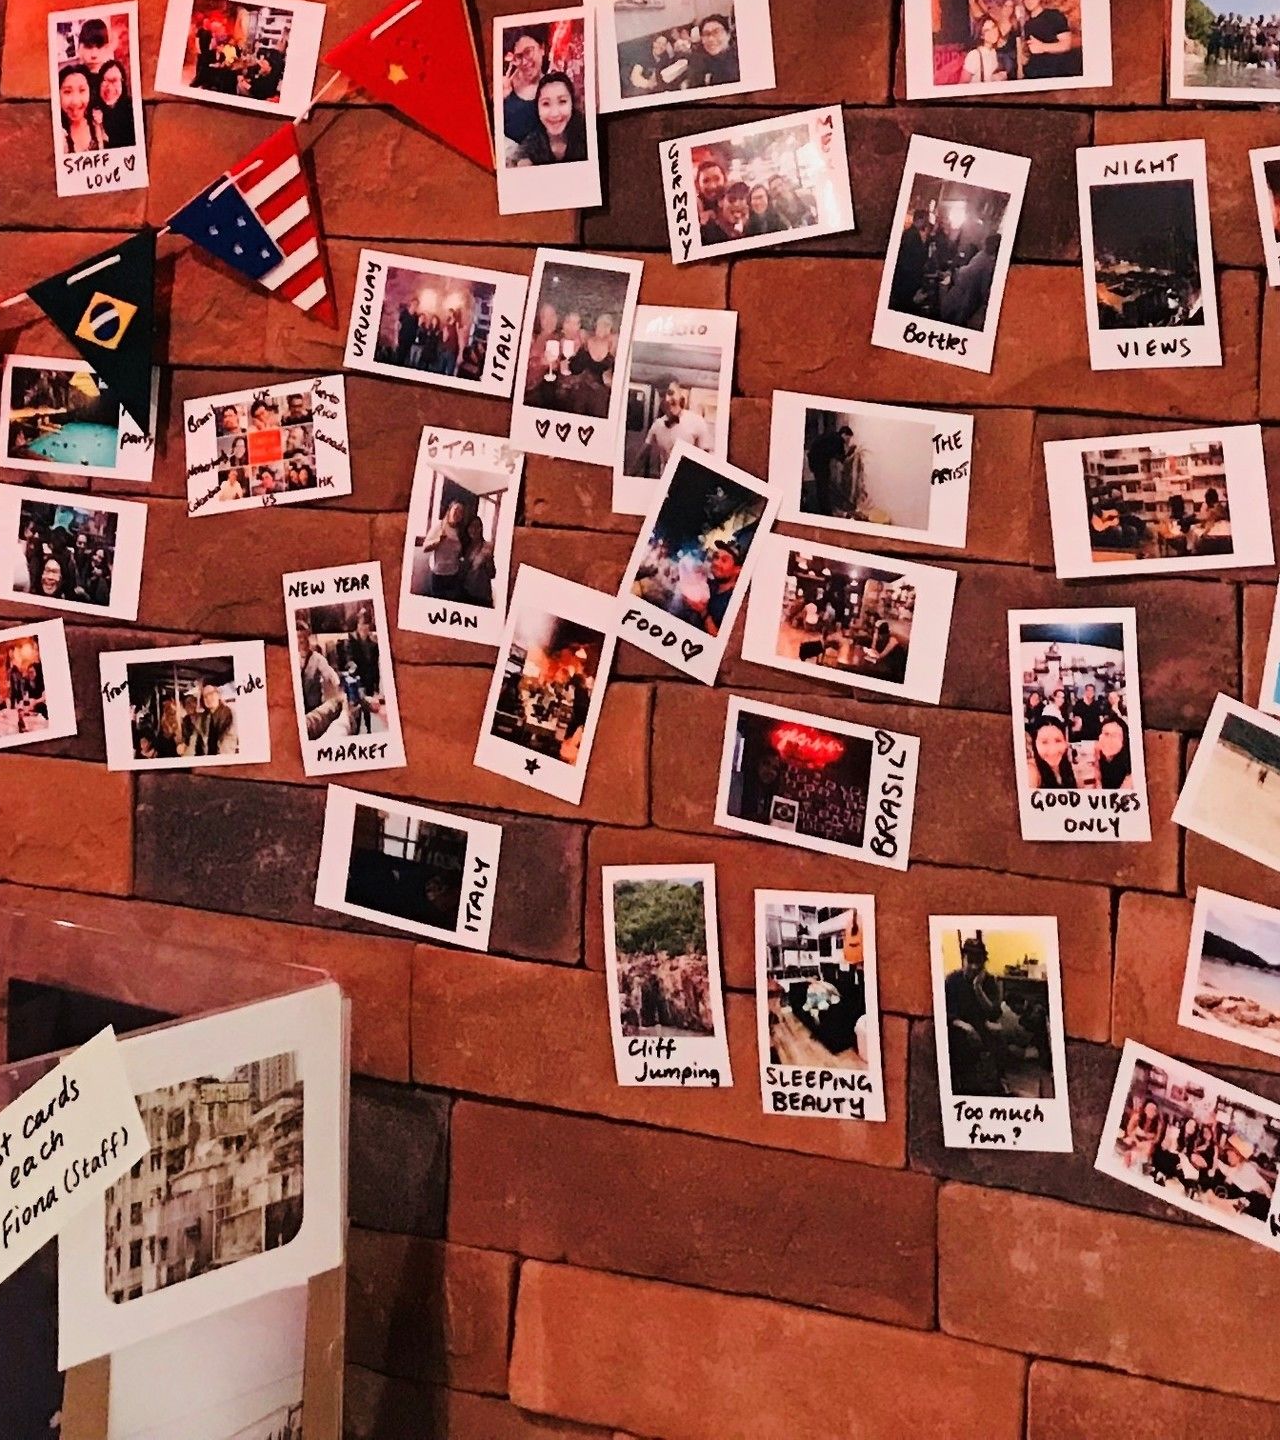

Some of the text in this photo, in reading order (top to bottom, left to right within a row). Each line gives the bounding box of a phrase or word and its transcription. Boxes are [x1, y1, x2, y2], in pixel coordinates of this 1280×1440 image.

[63, 152, 111, 175] STAFF
[942, 150, 977, 179] 99
[1103, 153, 1180, 178] NIGHT
[667, 143, 693, 261] GERMANY
[352, 260, 517, 382] URUGUAY ITALY
[902, 323, 969, 357] Bottles
[1116, 338, 1193, 359] VIEWS
[932, 430, 964, 455] THE
[929, 461, 971, 487] ARTIST
[288, 572, 371, 599] NEW YEAR
[427, 611, 479, 629] WAN
[621, 608, 679, 648] FOOD
[235, 675, 265, 698] ride
[316, 742, 389, 762] MARKET
[869, 748, 907, 859] BRASIL
[1029, 790, 1141, 814] GOOD VIBES
[1063, 816, 1121, 839] ONLY
[464, 856, 491, 933] ITALY
[627, 1037, 678, 1058] Cliff
[634, 1063, 721, 1087] Jumping
[765, 1066, 874, 1094] SLEEPING
[22, 1074, 81, 1140] cards
[771, 1091, 866, 1120] BEAUTY
[953, 1101, 1045, 1124] Too much
[9, 1130, 65, 1189] each
[1, 1185, 60, 1249] Fiona
[63, 1126, 129, 1194] (Staff)
